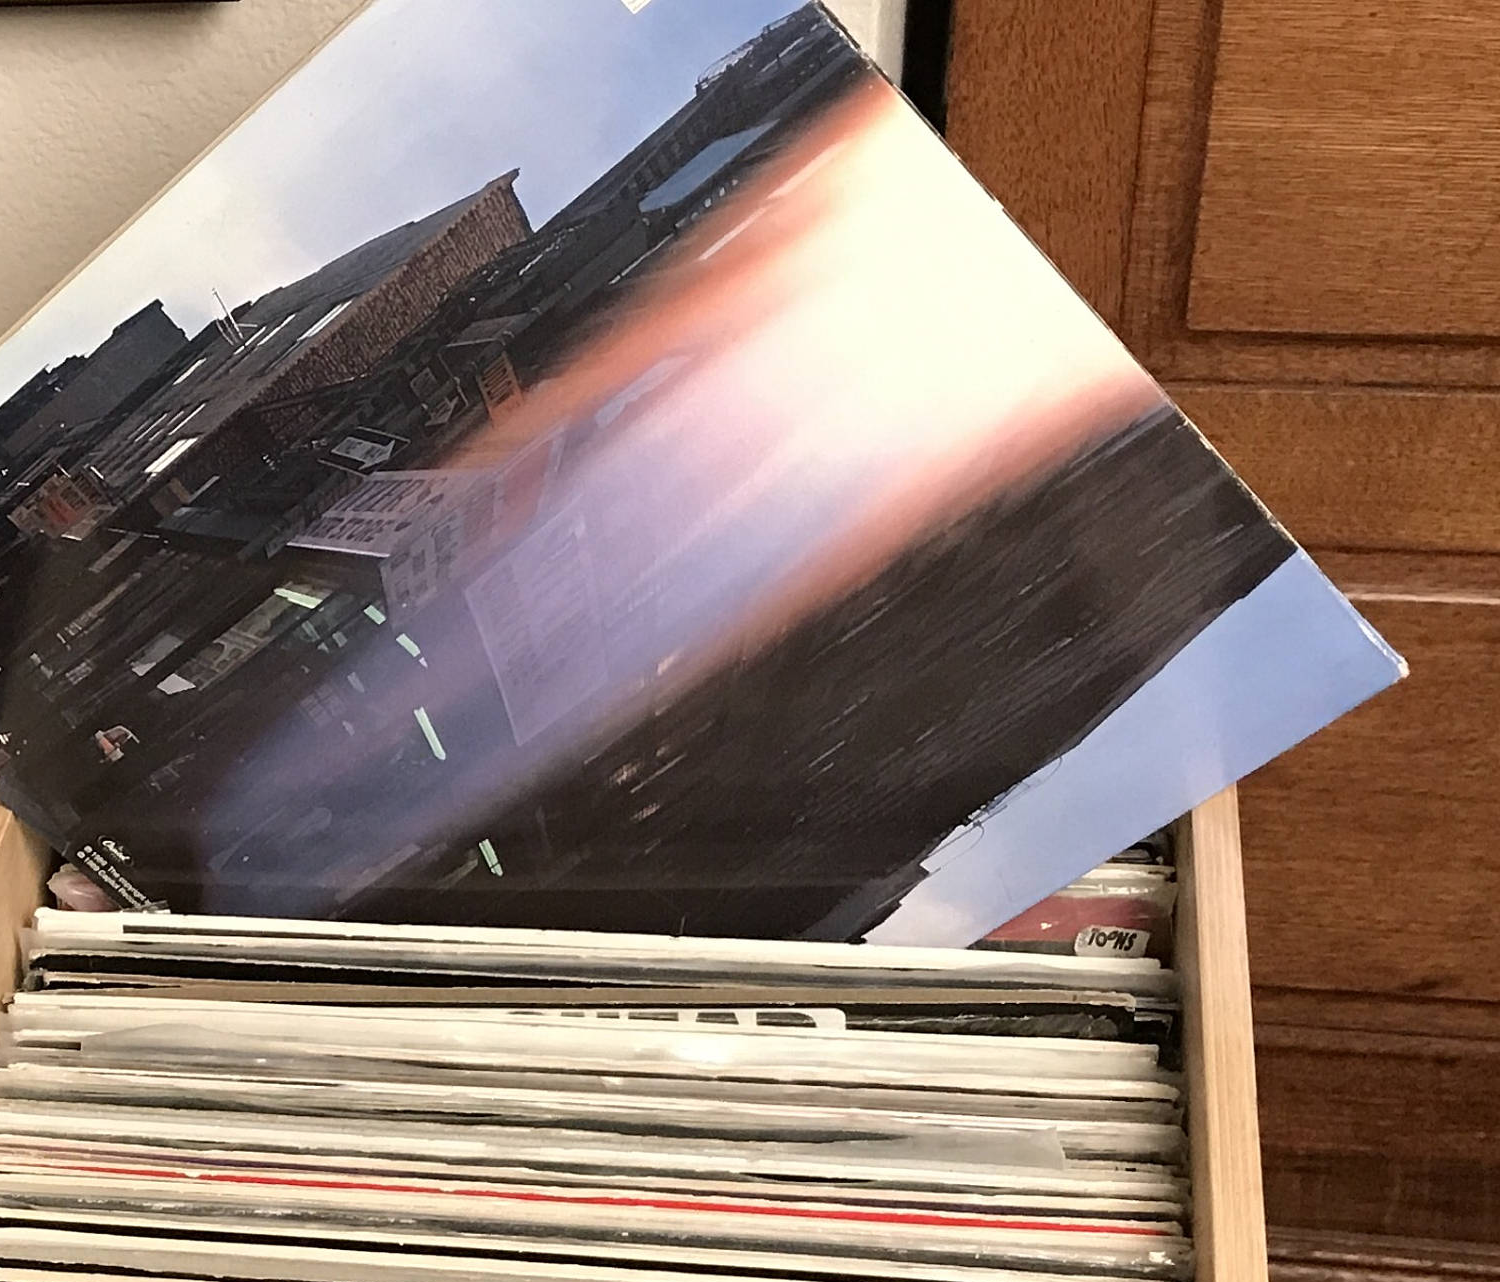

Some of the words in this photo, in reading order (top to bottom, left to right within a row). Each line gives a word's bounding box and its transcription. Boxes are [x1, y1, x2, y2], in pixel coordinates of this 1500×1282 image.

[328, 518, 395, 543] STORE
[107, 866, 121, 878] The
[119, 877, 147, 901] copyright
